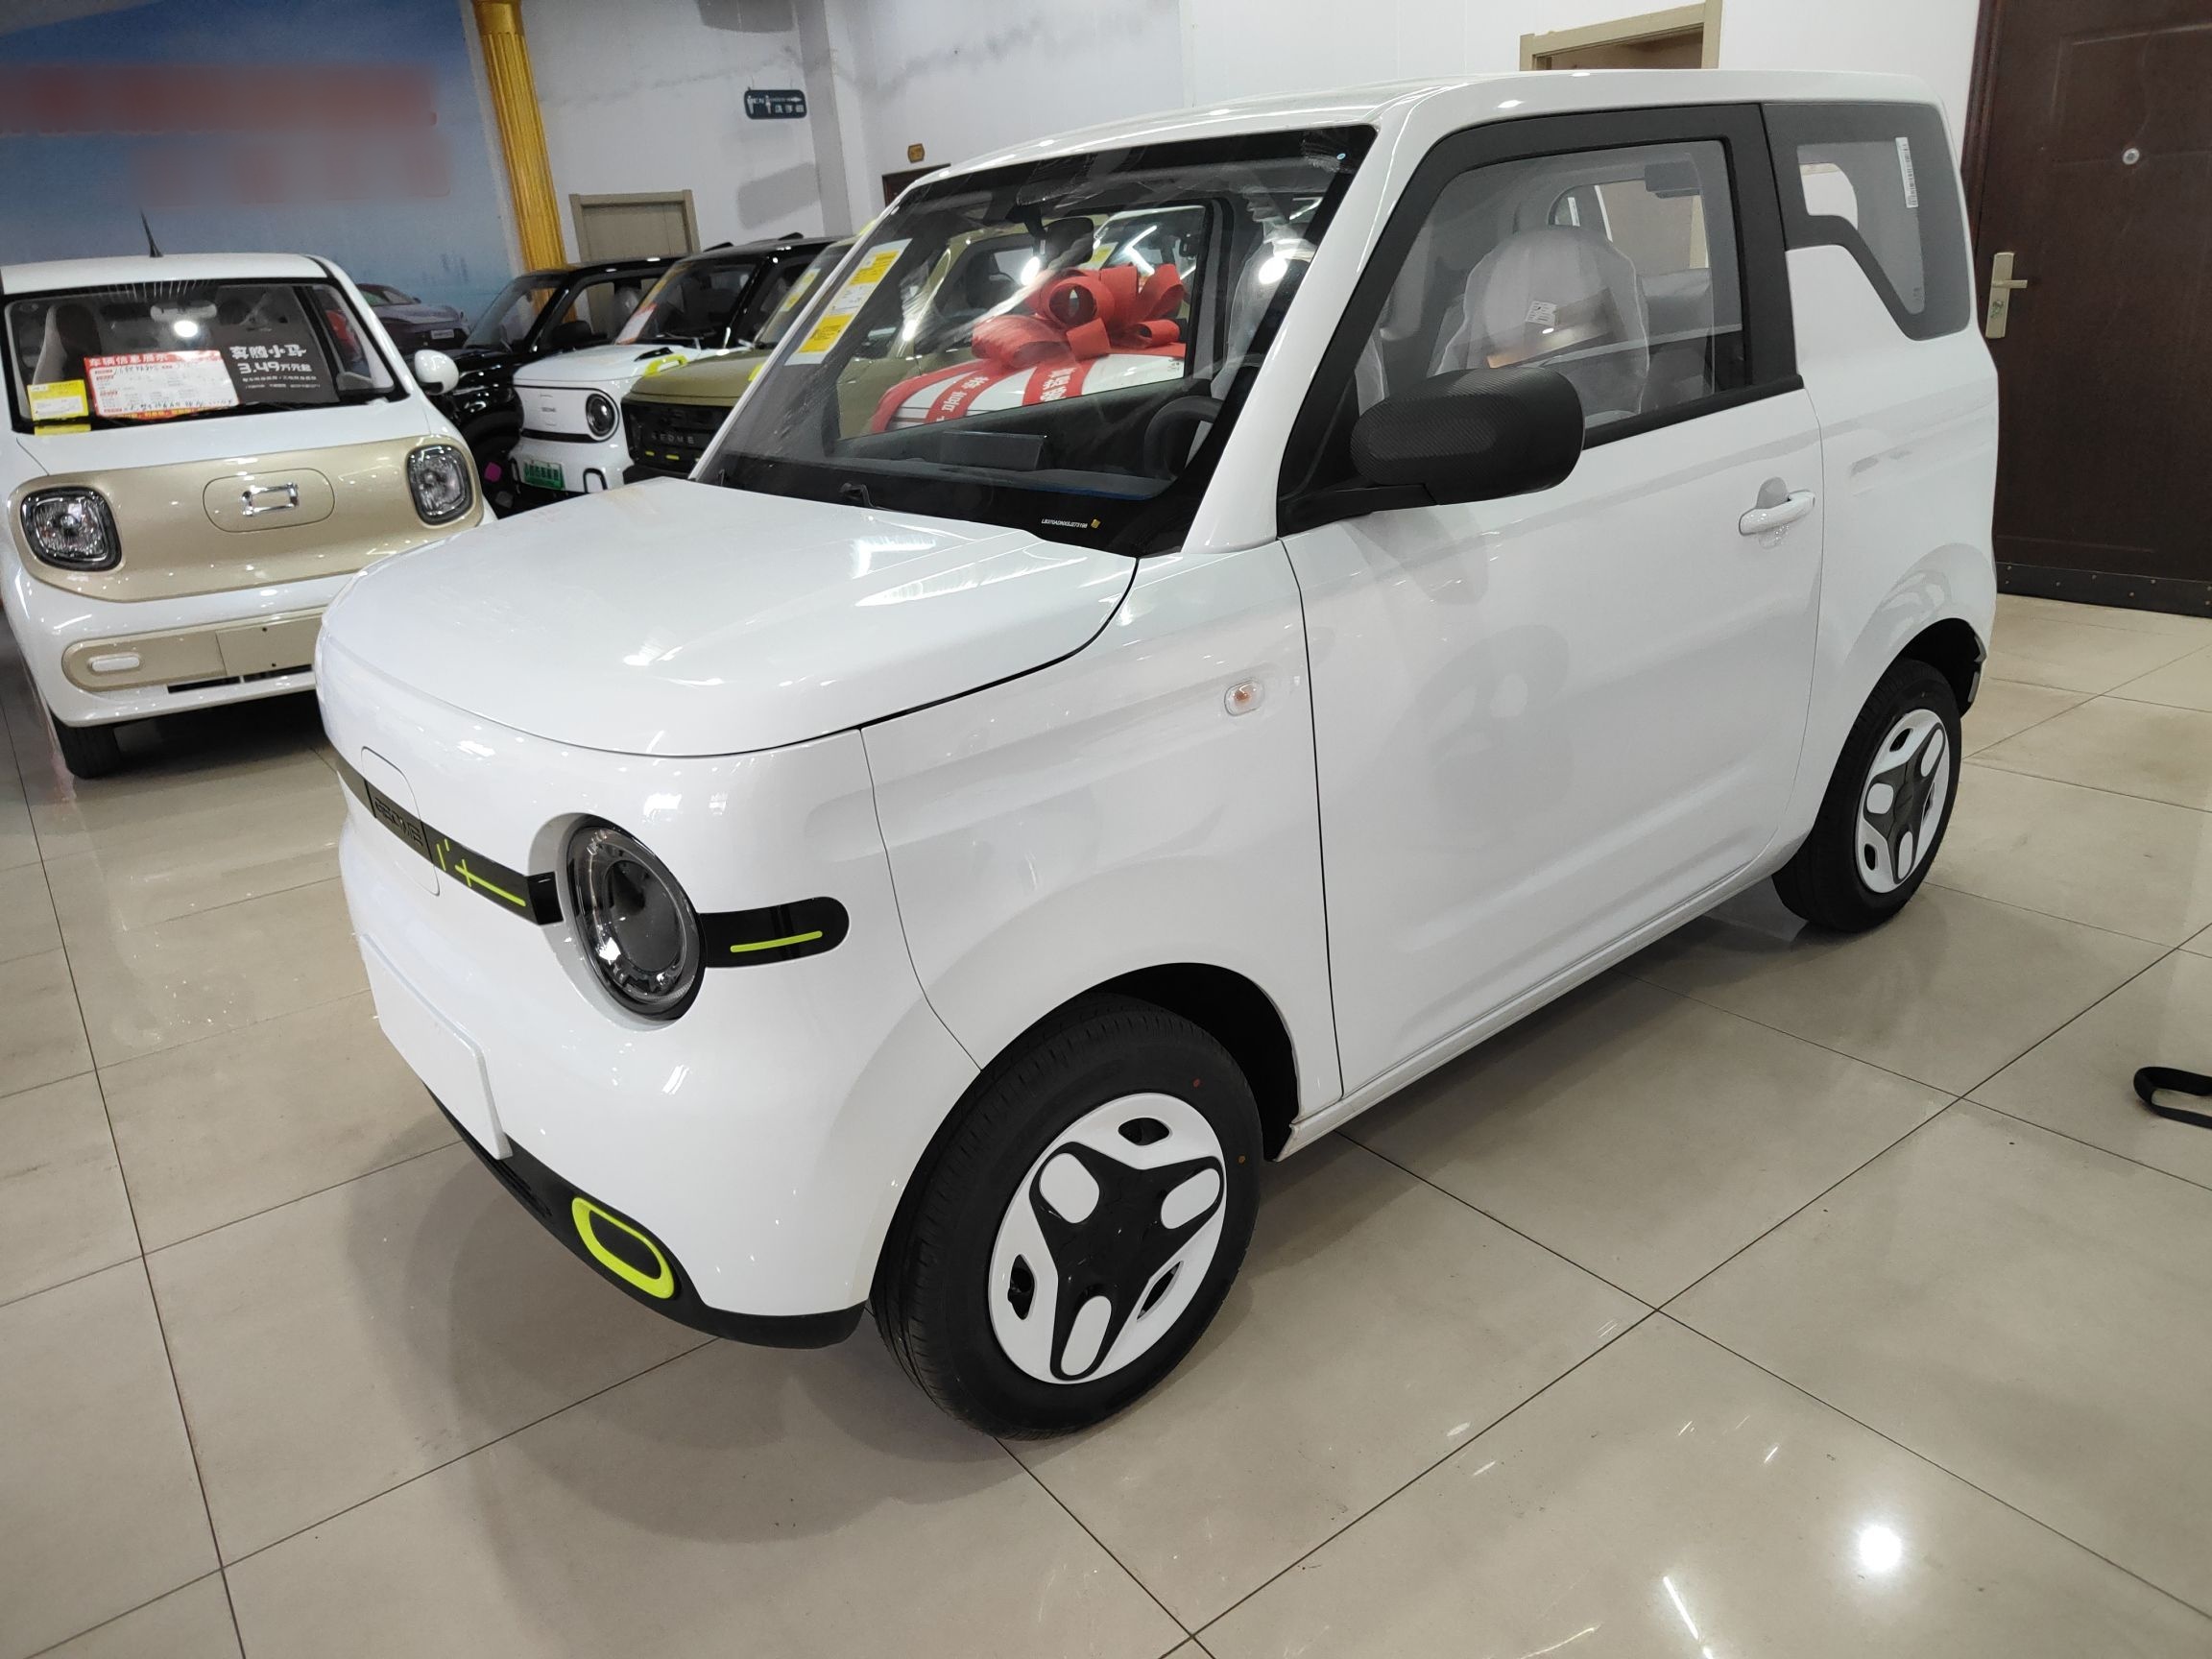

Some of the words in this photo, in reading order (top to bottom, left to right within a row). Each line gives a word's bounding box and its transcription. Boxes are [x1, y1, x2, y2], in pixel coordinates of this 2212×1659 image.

[228, 344, 307, 360] 奔腾小马
[237, 361, 312, 374] 3.49万元起
